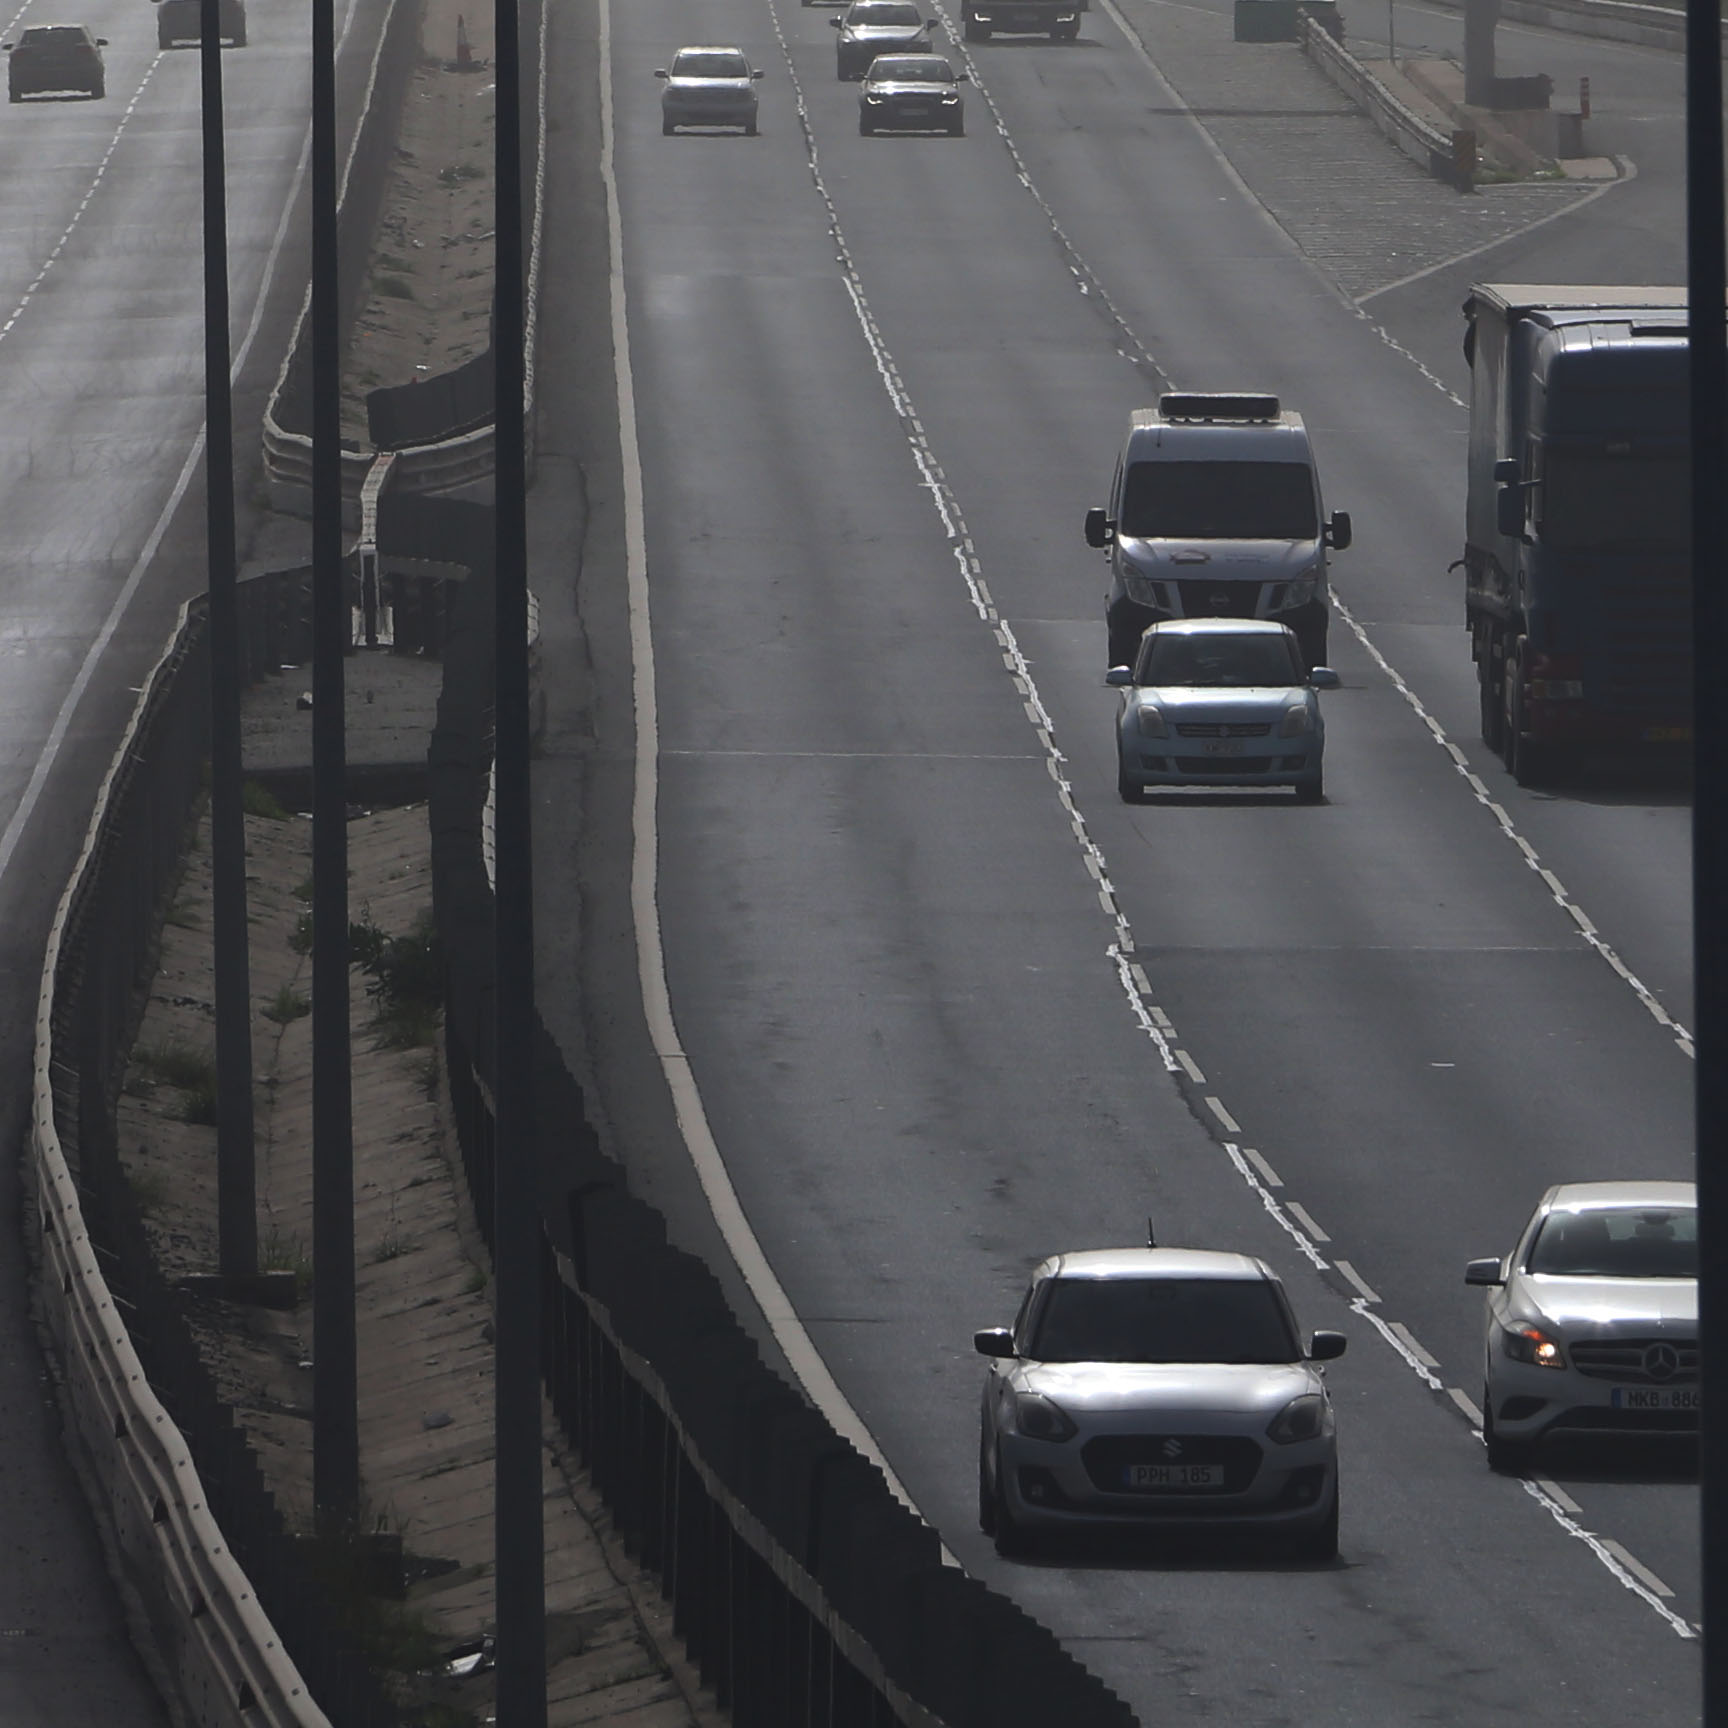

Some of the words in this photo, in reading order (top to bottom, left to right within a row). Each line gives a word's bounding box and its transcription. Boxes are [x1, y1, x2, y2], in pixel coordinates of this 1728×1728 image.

[1628, 1391, 1659, 1407] MKB
[1136, 1466, 1170, 1483] PPH
[1181, 1466, 1211, 1483] 185
